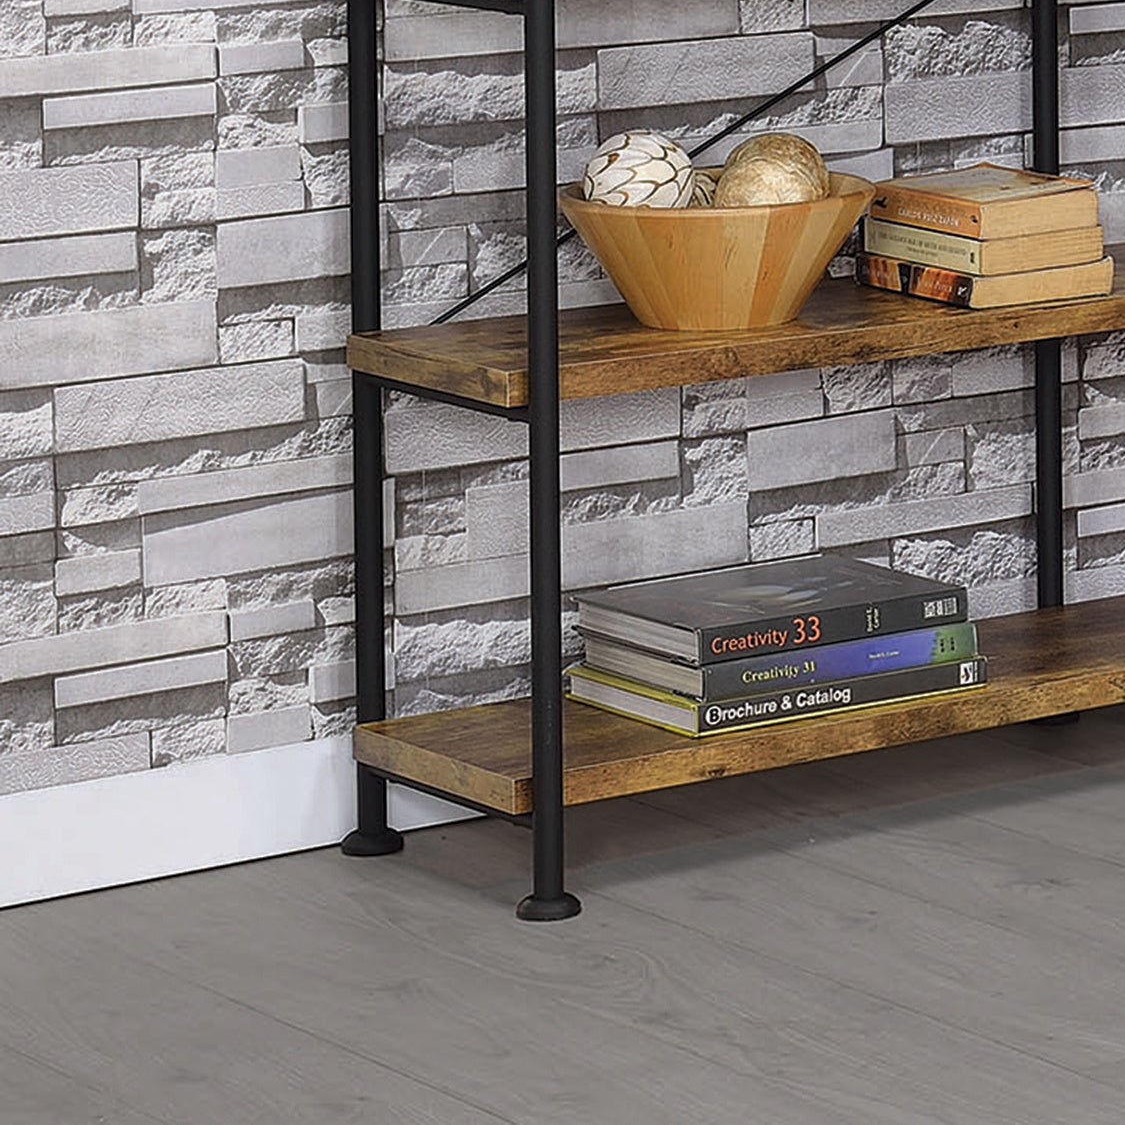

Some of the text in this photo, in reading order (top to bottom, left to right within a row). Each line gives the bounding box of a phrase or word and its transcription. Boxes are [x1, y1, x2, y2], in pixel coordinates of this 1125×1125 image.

[711, 616, 822, 654] Creativity 33
[742, 660, 816, 684] Creativity 31
[705, 686, 852, 725] Brochure & Catalog
